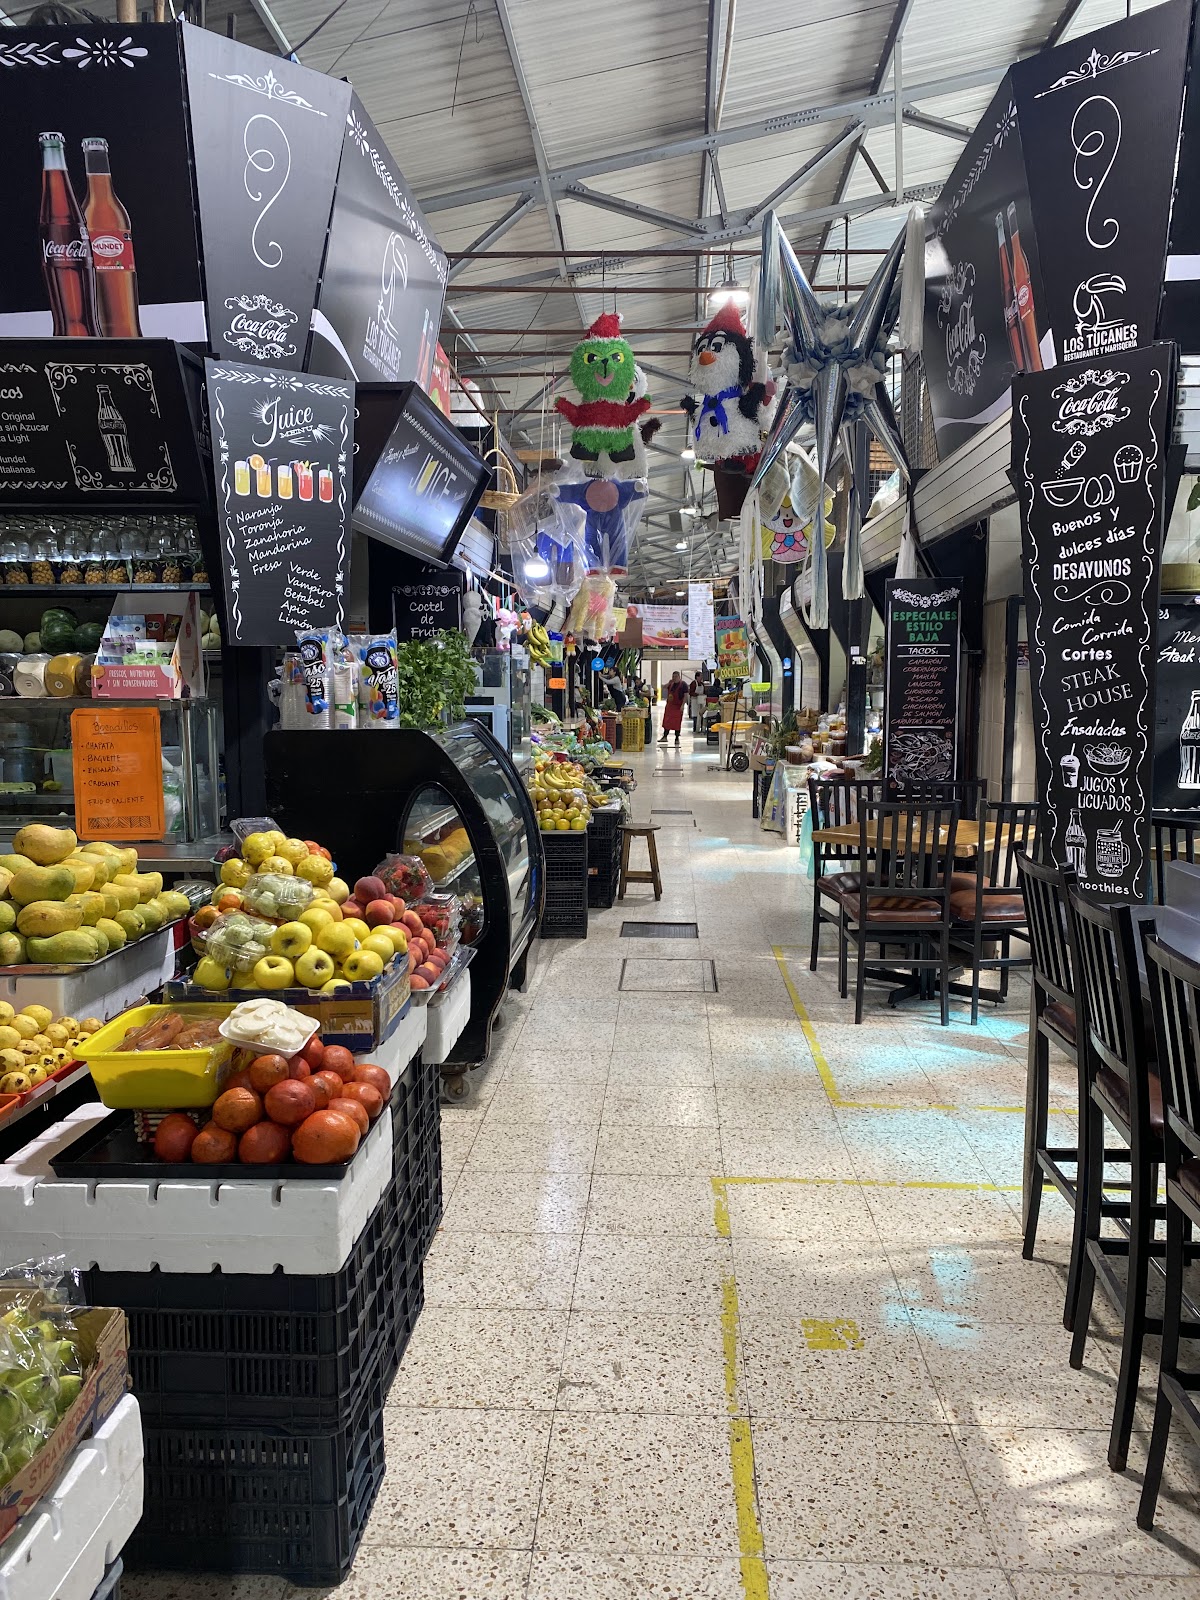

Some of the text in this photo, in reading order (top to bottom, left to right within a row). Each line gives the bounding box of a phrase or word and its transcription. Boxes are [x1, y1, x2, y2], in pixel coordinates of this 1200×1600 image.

[46, 240, 87, 257] Coca-Cola
[231, 313, 290, 343] Coca-Cola
[946, 293, 976, 367] Coca-Cola
[1064, 324, 1138, 354] LOS TUCANES
[1064, 347, 1099, 362] RESTAURANTE
[1059, 387, 1121, 419] Coca-Cola
[1, 412, 35, 422] Original
[252, 397, 313, 447] Juice
[20, 423, 49, 431] Azucar
[279, 425, 313, 439] MENU
[8, 434, 30, 444] Light
[236, 503, 282, 524] Naranja
[1052, 506, 1120, 537] Buenos y
[239, 517, 284, 536] Toronja
[244, 524, 306, 549] Zanahoria
[1058, 525, 1136, 559] dulces días
[248, 538, 312, 562] Mandarina
[252, 560, 282, 576] Fresa
[290, 561, 321, 581] Verde
[1053, 558, 1131, 580] DESAYUNOS
[287, 573, 335, 598] Vampiro
[284, 587, 325, 608] Betabel
[409, 601, 445, 612] Coctel
[281, 600, 310, 615] Apio
[893, 611, 957, 621] ESPECIALES
[278, 612, 316, 630] Limón
[420, 613, 434, 624] de
[906, 622, 943, 631] ESTILO
[1052, 608, 1101, 634] Comida
[909, 633, 939, 641] BAJA
[1081, 619, 1133, 645] Corrida
[1061, 648, 1113, 661] Cortes
[1157, 646, 1196, 663] Steak
[109, 670, 156, 678] FRESCOS, NUTRITIVOS
[310, 678, 322, 688] 25
[368, 669, 397, 687] Vaso
[1061, 663, 1121, 692] STEAK
[386, 683, 396, 694] 25
[1066, 683, 1133, 713] HOUSE
[936, 717, 955, 725] ATÚN
[1060, 716, 1127, 737] Ensaladas
[86, 742, 115, 750] CHAPATA
[87, 765, 121, 774] ENSALADA
[1080, 776, 1129, 793] JUGOS Y
[1078, 793, 1131, 812] LICUADOS
